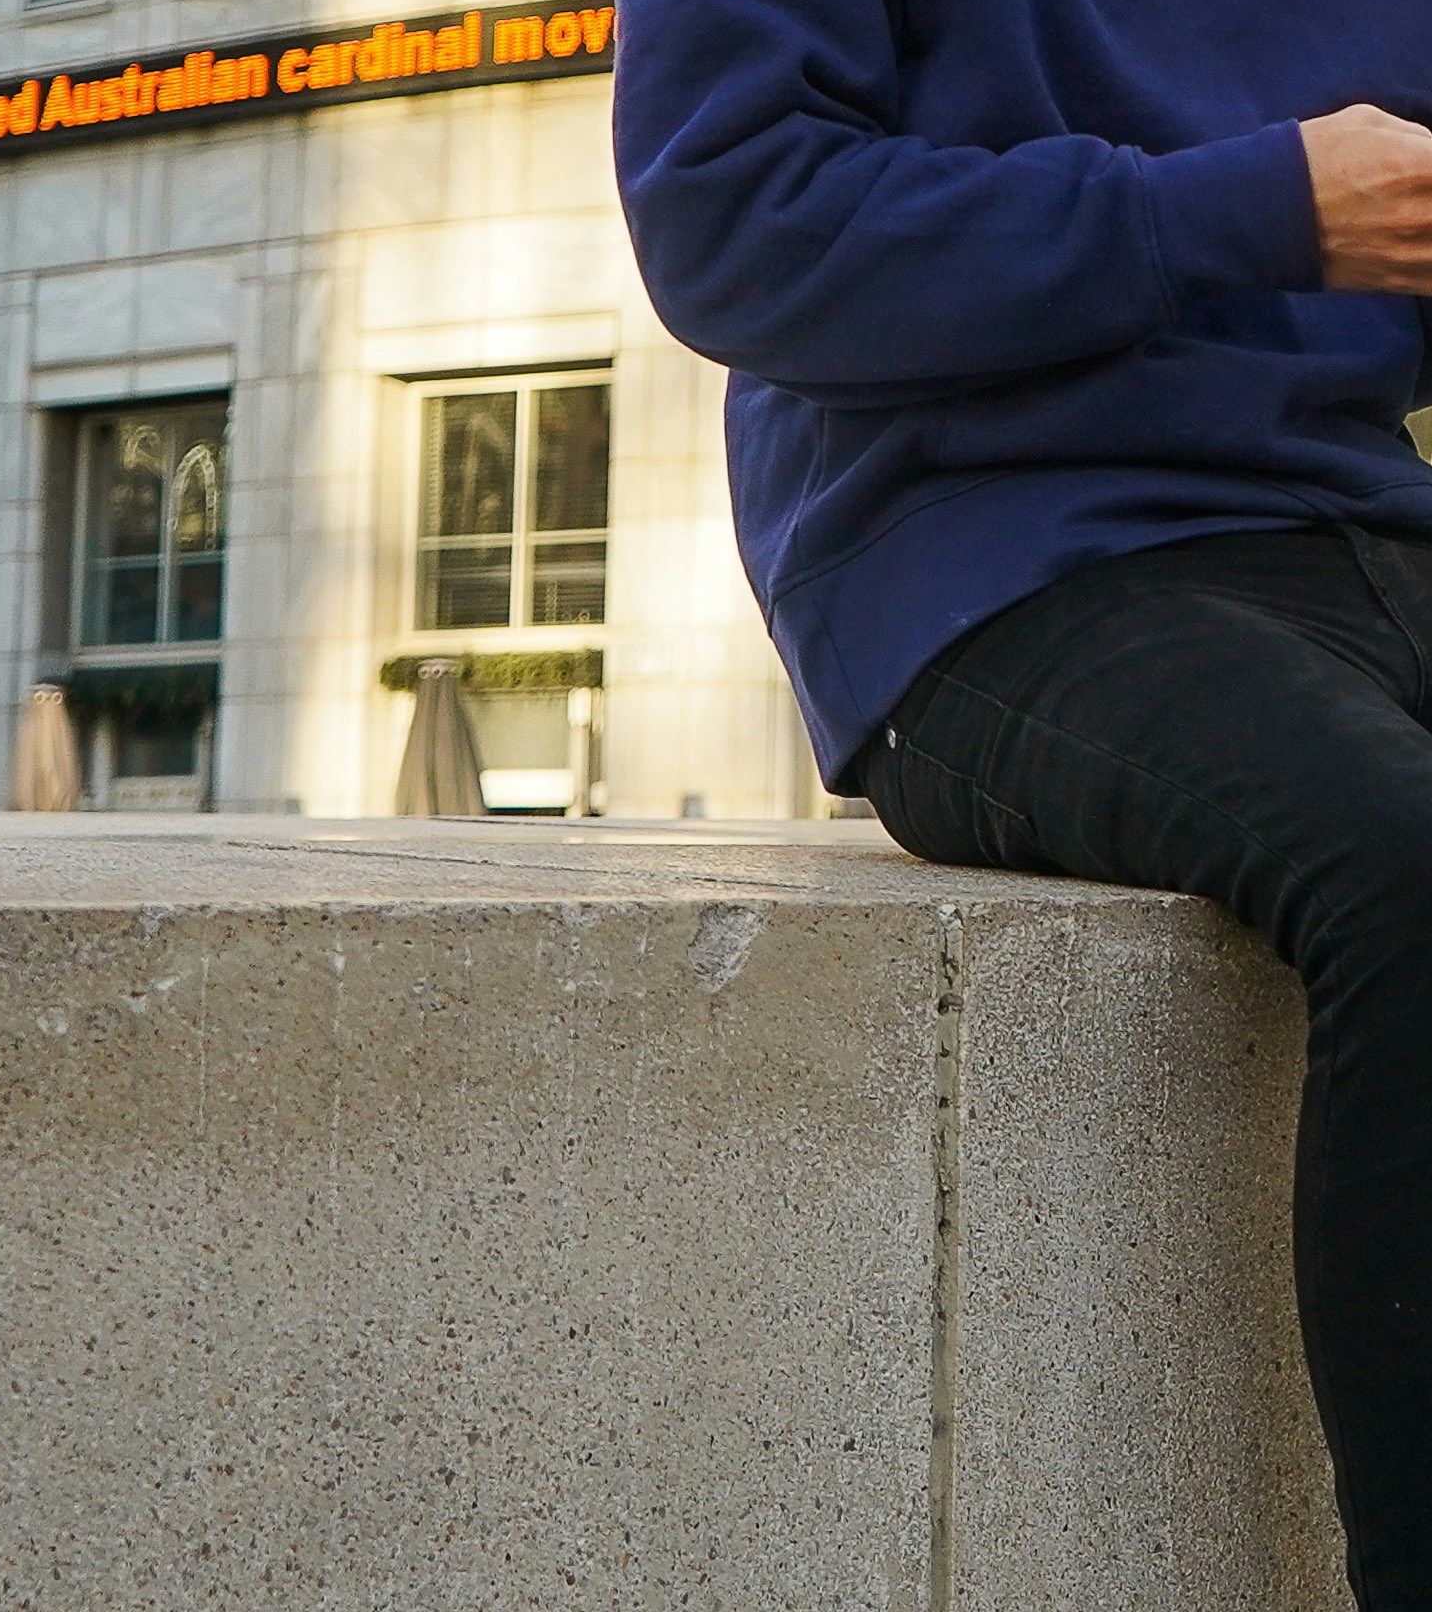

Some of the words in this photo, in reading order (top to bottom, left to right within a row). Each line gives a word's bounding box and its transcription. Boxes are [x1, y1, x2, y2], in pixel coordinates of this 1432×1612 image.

[38, 50, 269, 131] Australian
[276, 10, 483, 94] cardinal
[493, 6, 617, 65] mov
